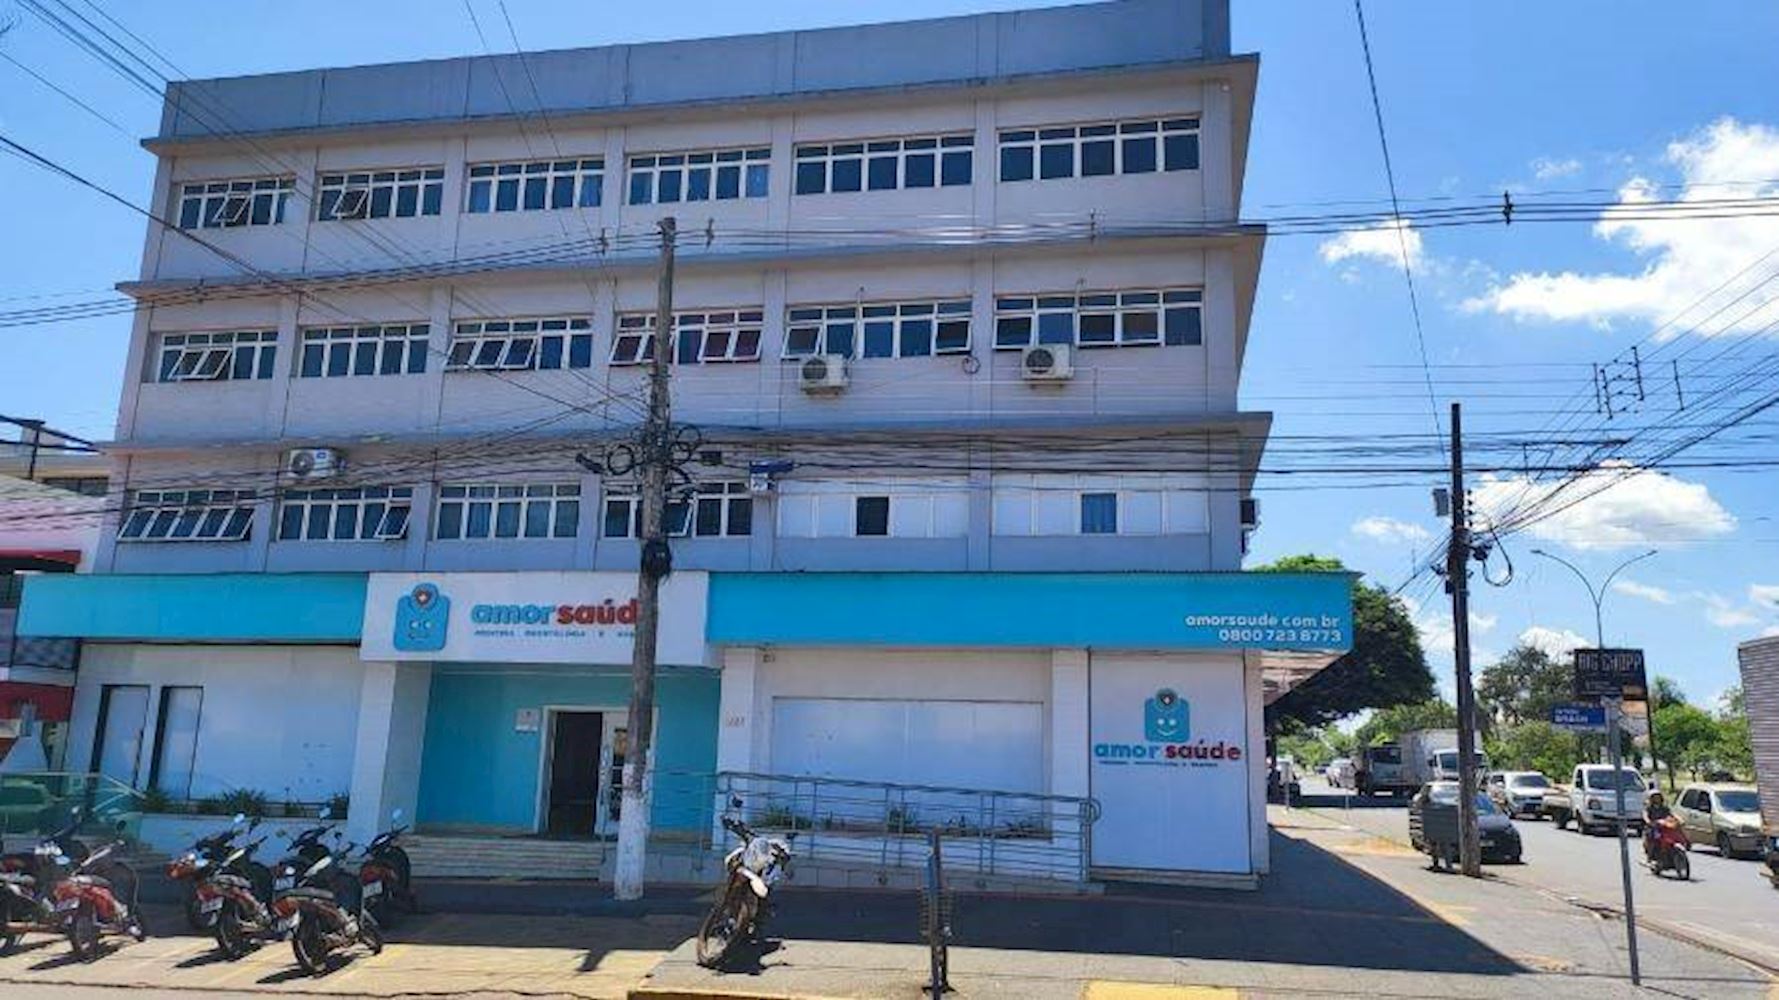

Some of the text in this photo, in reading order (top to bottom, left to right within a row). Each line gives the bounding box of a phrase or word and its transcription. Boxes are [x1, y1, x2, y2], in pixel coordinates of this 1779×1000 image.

[471, 598, 639, 625] amorsaúd
[1218, 629, 1342, 642] 0800 723 8773
